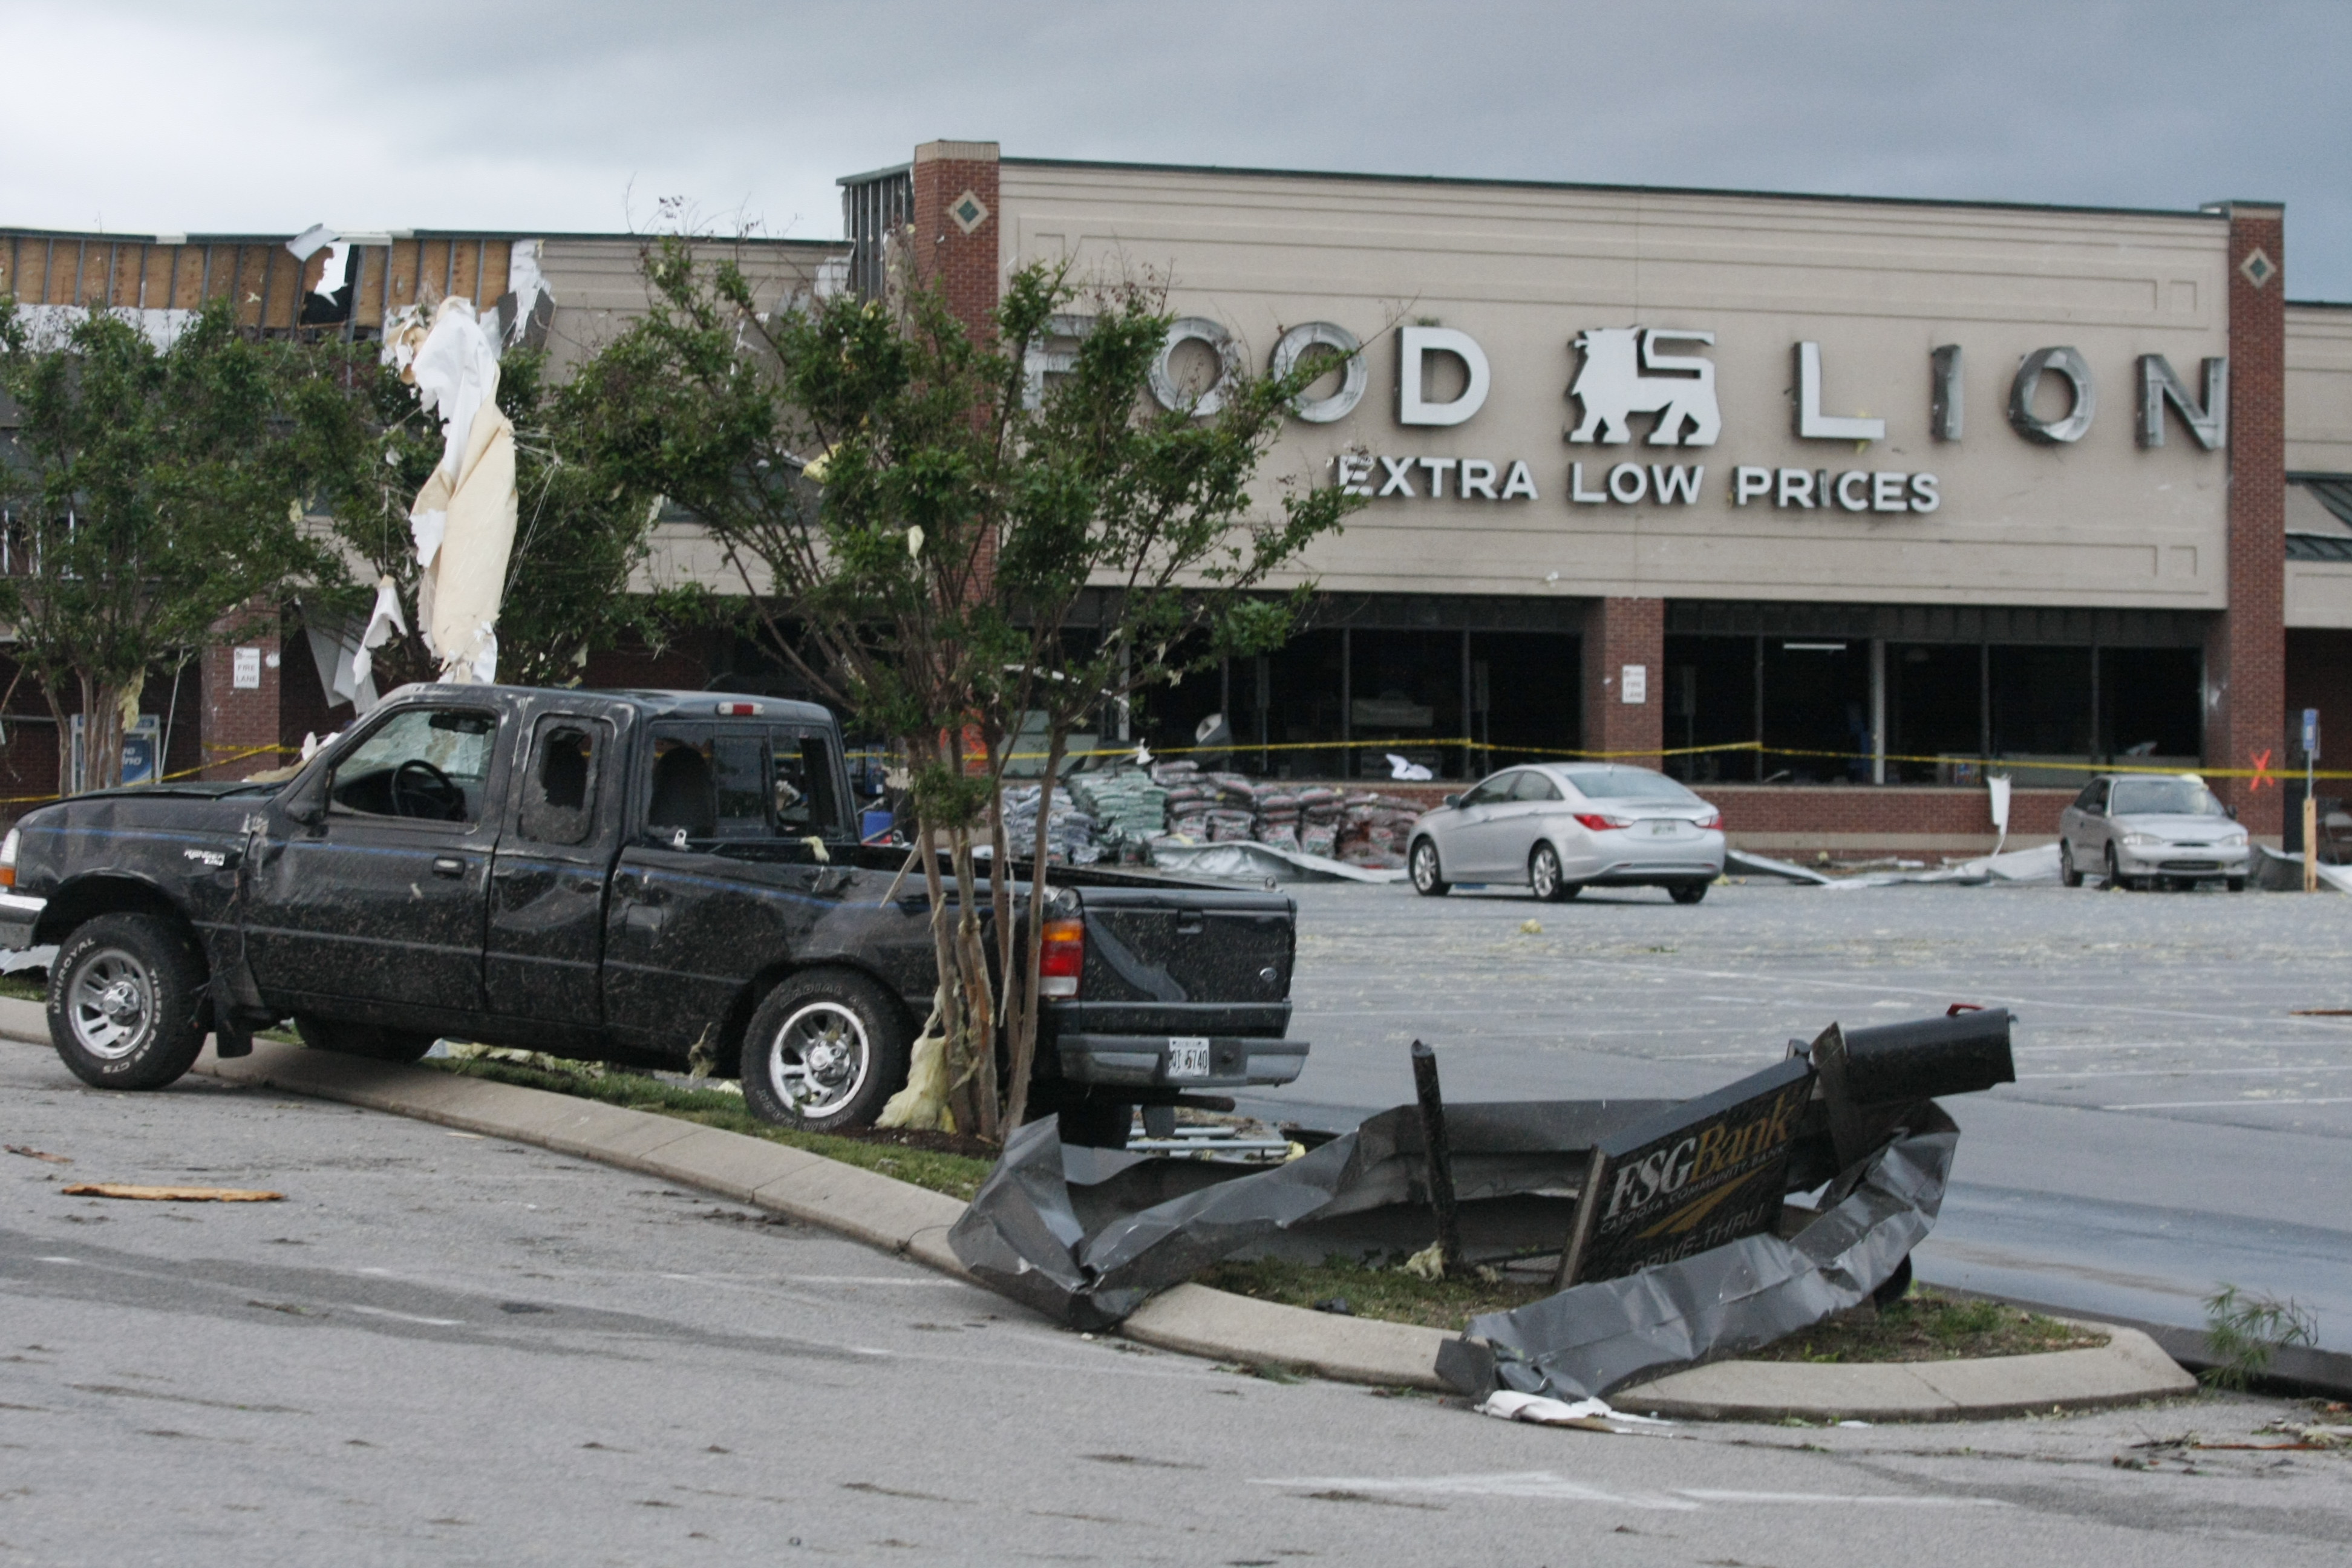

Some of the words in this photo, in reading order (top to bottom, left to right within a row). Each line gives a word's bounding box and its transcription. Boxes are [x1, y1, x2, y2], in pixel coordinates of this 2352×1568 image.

[1022, 314, 1491, 426] FOOD
[1792, 341, 2227, 451] LION
[1335, 454, 1538, 501] EXTRA
[1569, 462, 1705, 506] LOW
[1733, 466, 1941, 514] PRICES
[53, 938, 96, 1014] UNIROYAL
[150, 969, 162, 1025] TIGER
[1668, 1160, 1748, 1204] COMMUNITY
